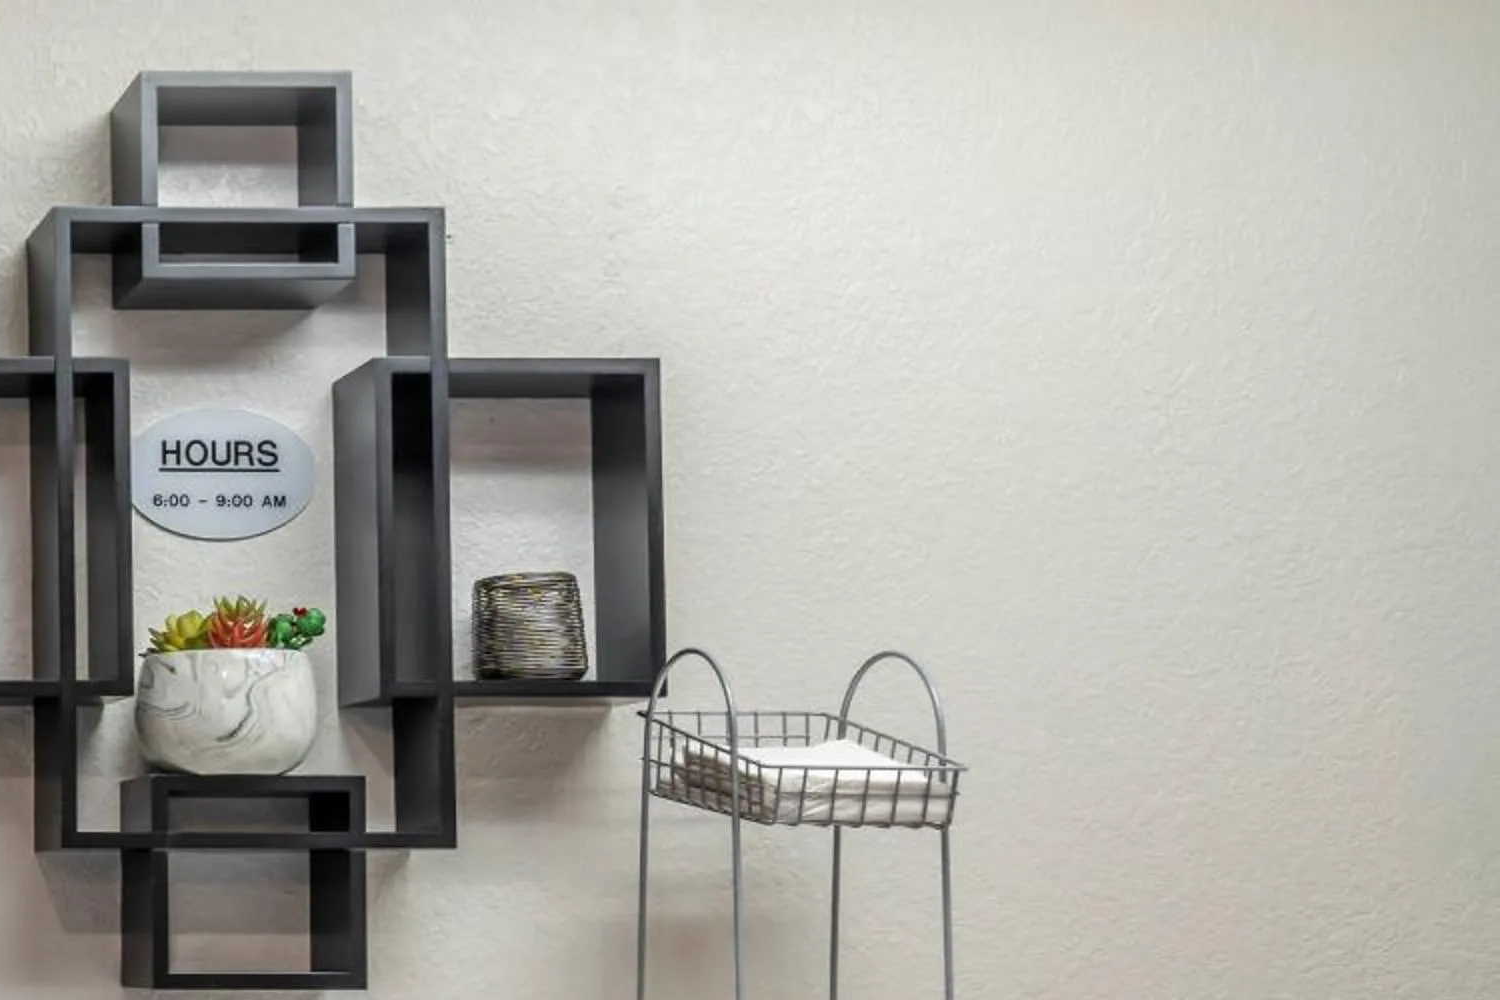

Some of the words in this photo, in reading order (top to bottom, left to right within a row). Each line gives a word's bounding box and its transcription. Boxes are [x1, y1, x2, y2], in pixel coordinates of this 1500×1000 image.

[161, 439, 279, 467] HOURS
[153, 494, 191, 508] 6:00
[215, 494, 253, 508] 9:00
[262, 495, 287, 508] AM
